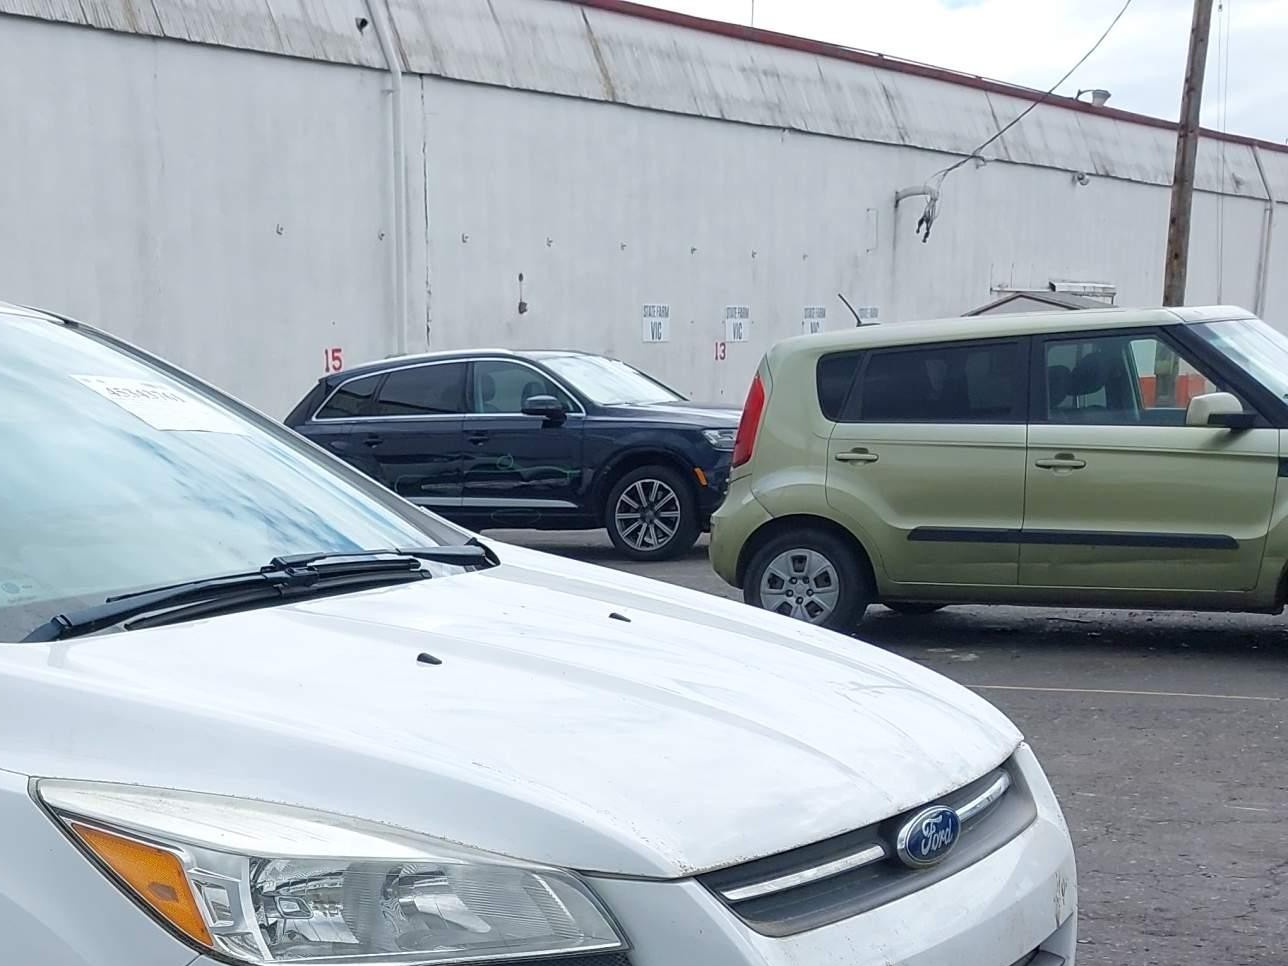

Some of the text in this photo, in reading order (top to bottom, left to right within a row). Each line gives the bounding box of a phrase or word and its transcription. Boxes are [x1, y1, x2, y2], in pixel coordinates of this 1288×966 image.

[643, 305, 669, 318] STATE FARM
[650, 321, 662, 340] VIC
[733, 322, 743, 340] VIC
[324, 348, 342, 373] 15
[715, 342, 726, 361] 13
[921, 814, 953, 856] Ford
